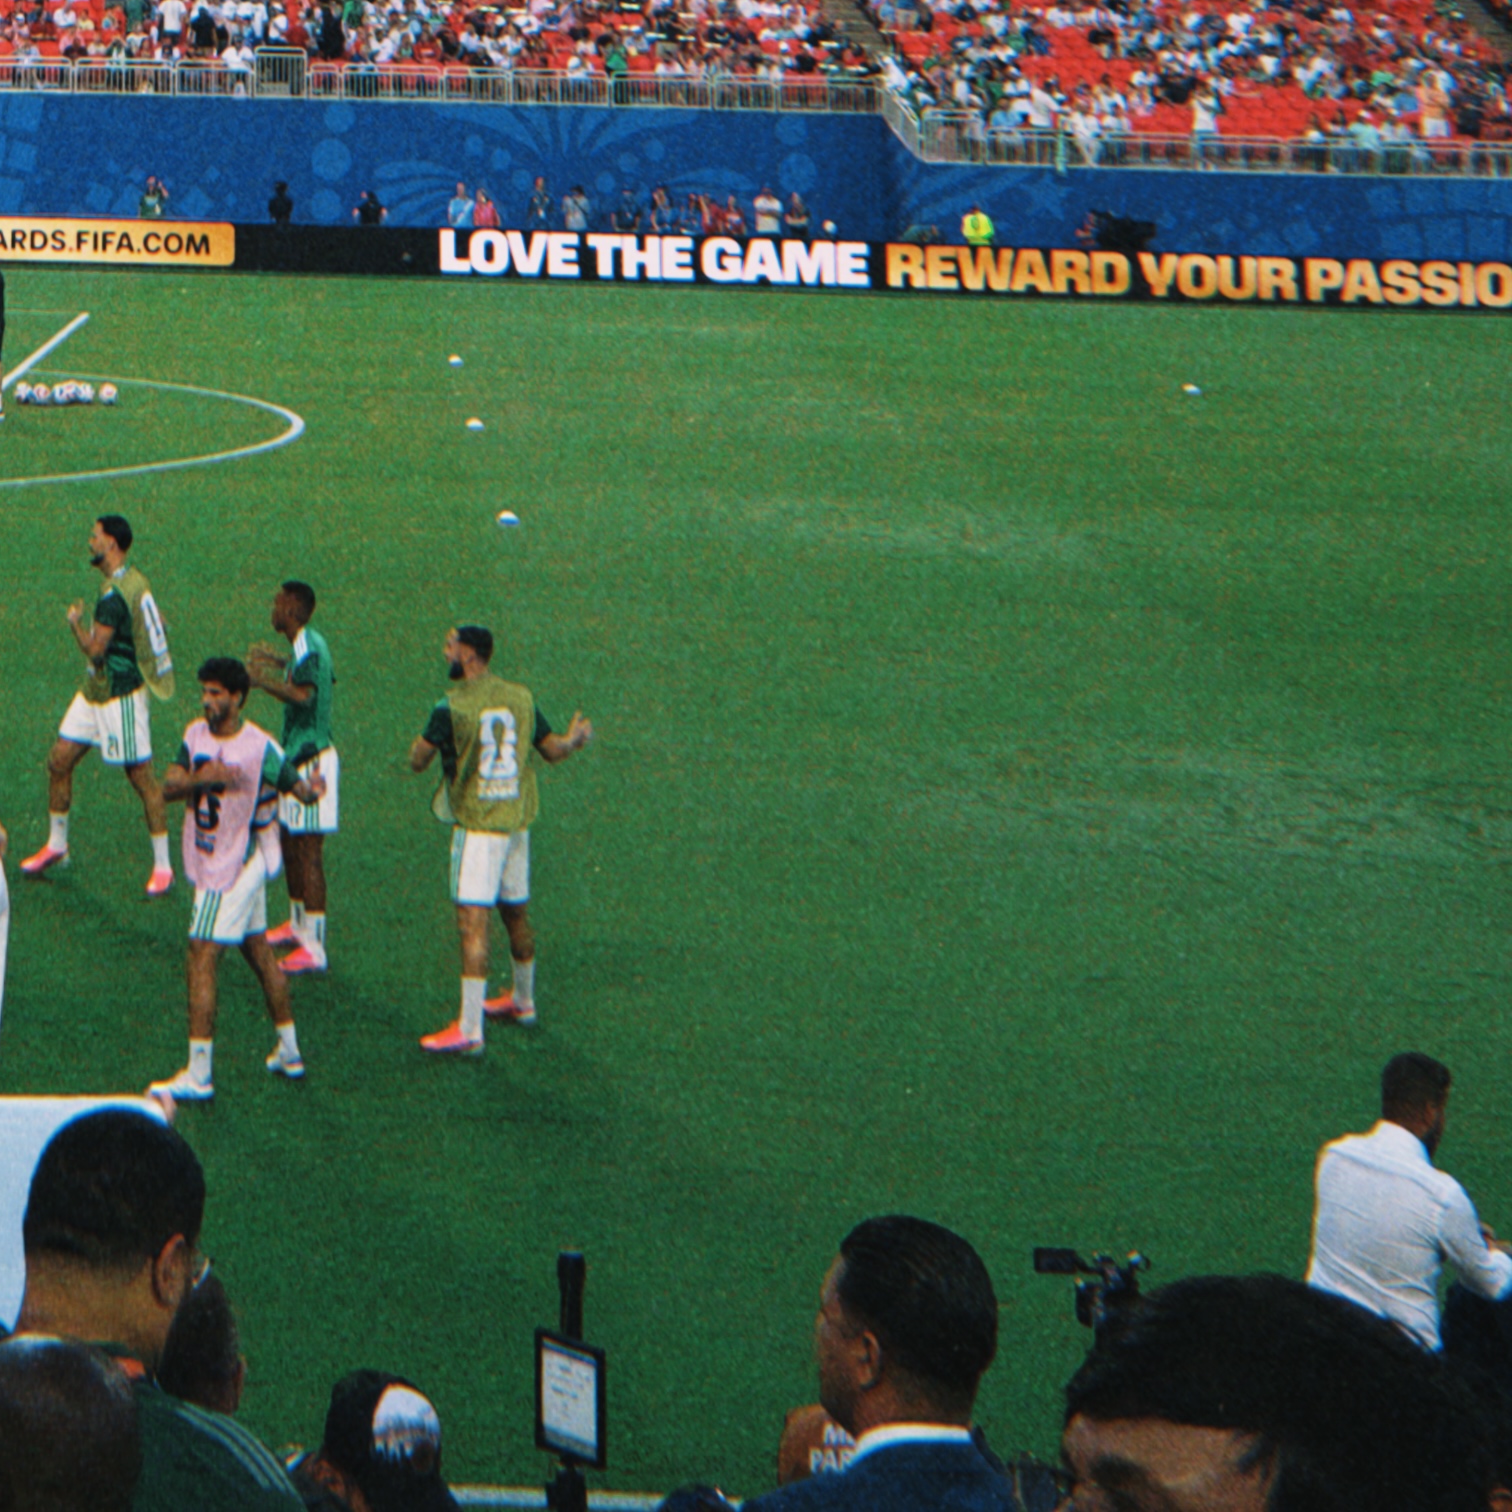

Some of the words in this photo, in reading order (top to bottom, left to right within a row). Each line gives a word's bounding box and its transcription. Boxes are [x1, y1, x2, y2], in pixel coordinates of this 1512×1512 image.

[439, 229, 581, 277] LOVE
[587, 234, 695, 280] THE
[701, 237, 870, 288] GAME
[886, 243, 1131, 295] REWARD
[1137, 252, 1299, 301] YOUR
[1305, 258, 1512, 308] PASSIO
